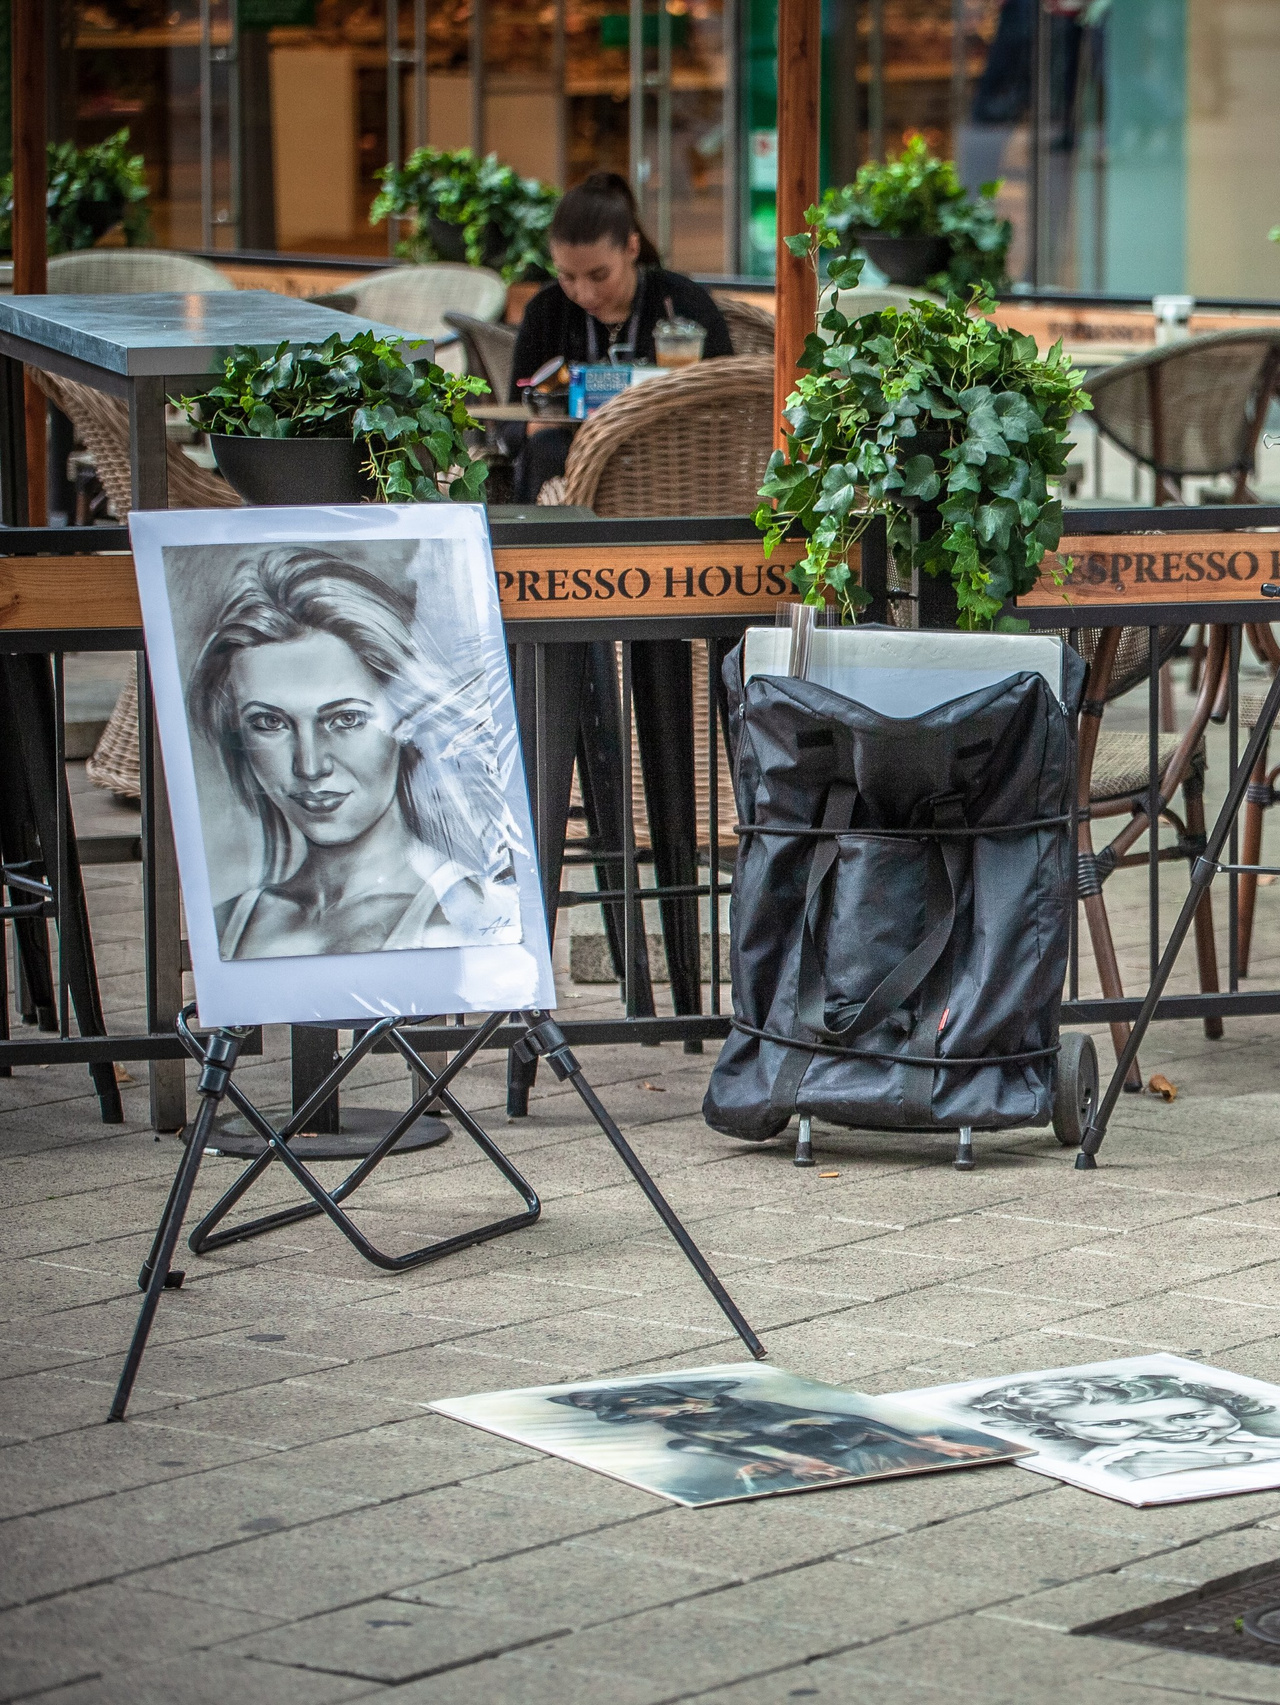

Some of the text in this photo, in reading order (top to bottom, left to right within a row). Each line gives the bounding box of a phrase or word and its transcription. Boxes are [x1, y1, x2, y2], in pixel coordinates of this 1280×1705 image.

[495, 564, 800, 602] PRESSO HOUS
[1062, 550, 1259, 586] ESPRESSO
